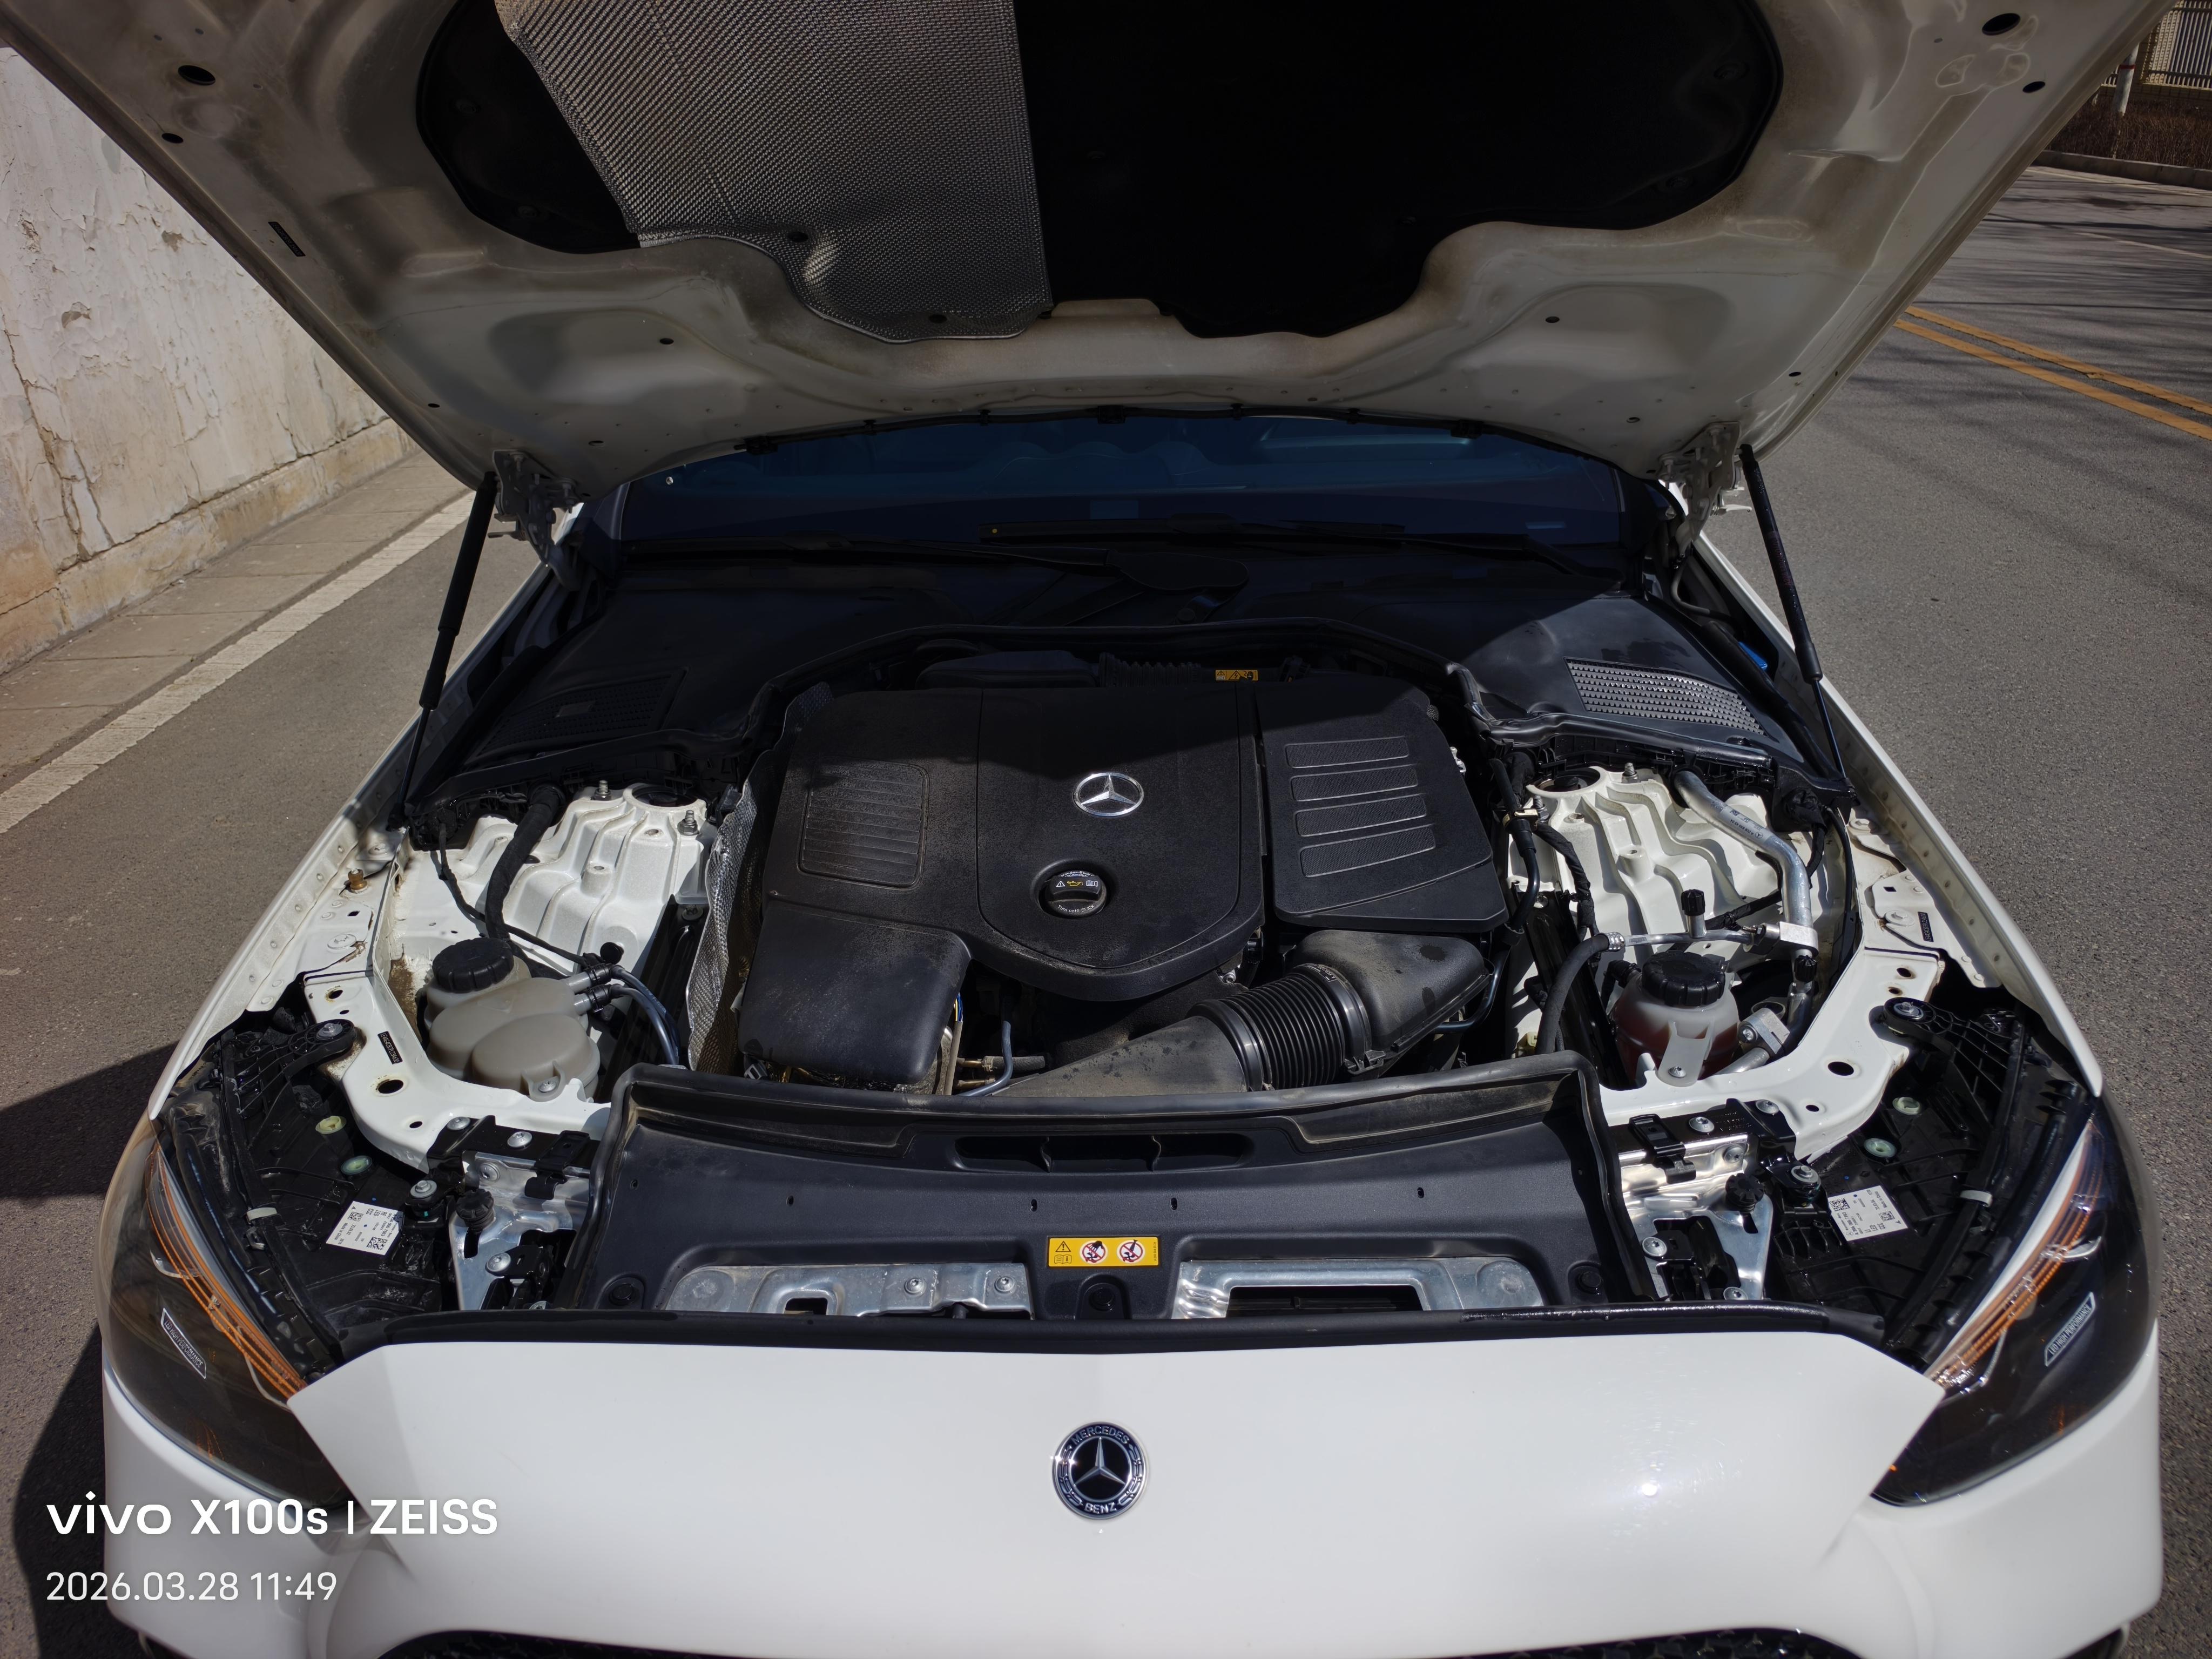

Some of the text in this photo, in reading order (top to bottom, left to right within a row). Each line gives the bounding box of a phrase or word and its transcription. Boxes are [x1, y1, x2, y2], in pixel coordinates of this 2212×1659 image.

[164, 1320, 204, 1368] LED HIGH PERFORMANCE
[1071, 1426, 1130, 1445] MERCEDES
[1084, 1502, 1117, 1514] BENZ
